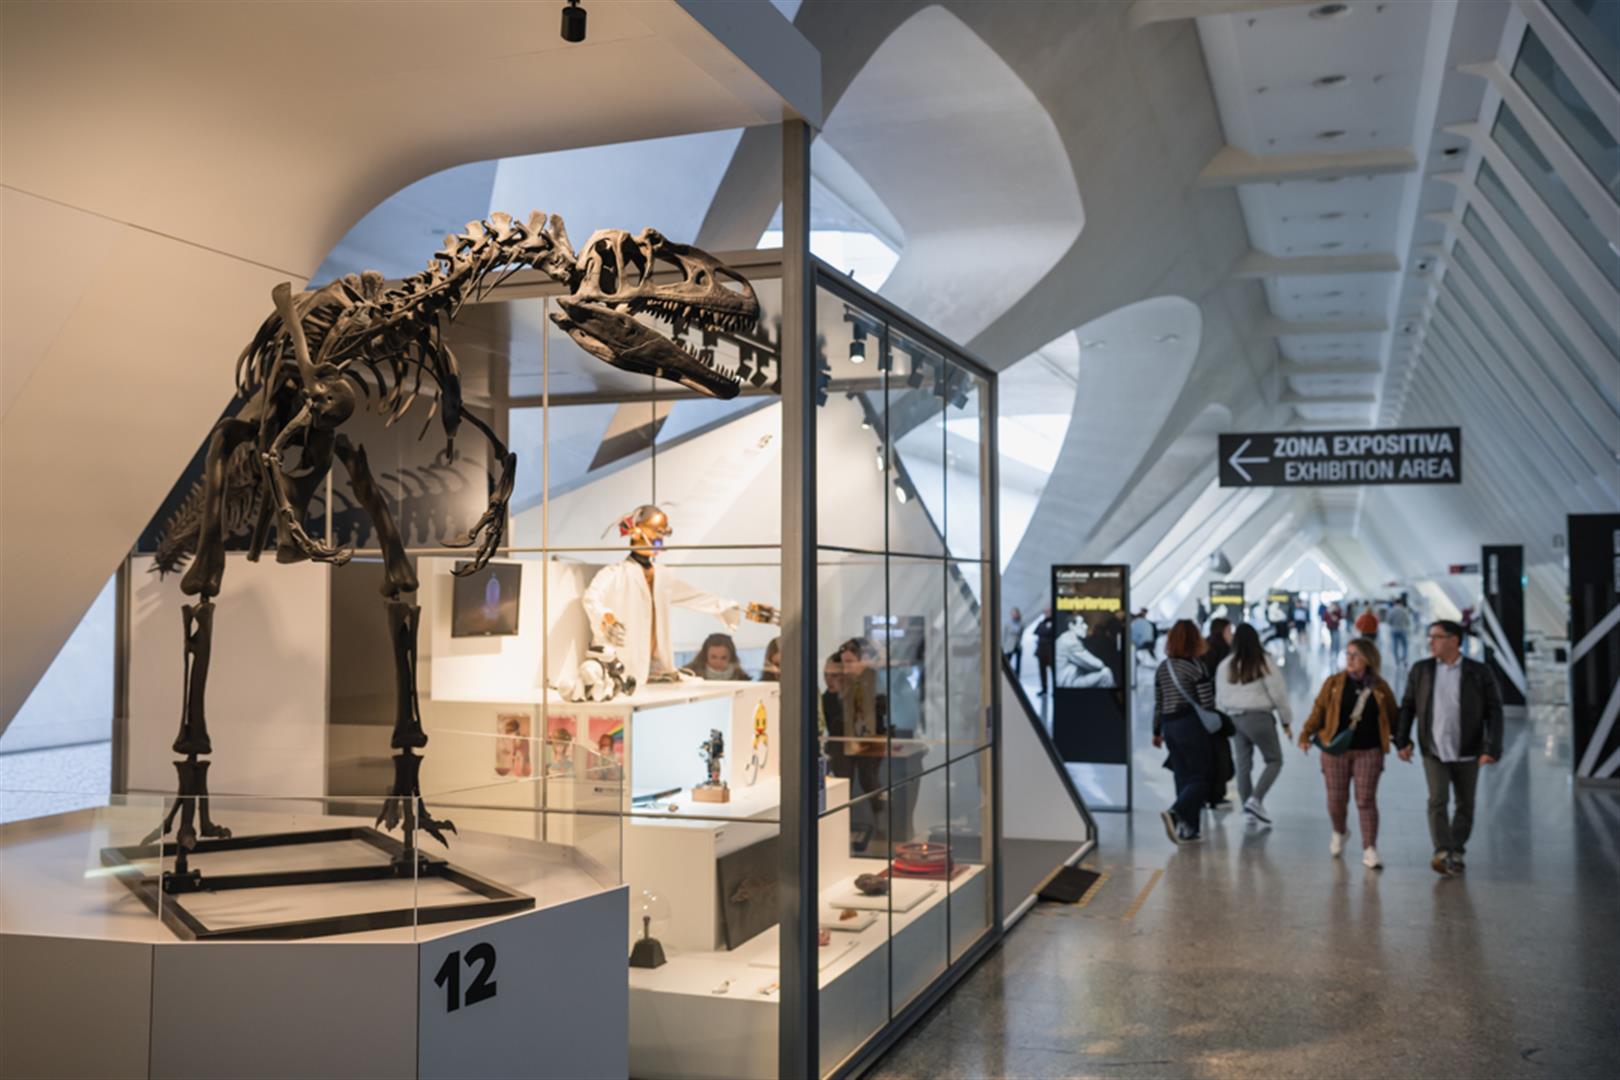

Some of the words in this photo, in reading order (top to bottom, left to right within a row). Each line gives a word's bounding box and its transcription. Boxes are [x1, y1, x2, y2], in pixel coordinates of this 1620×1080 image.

[1273, 437, 1328, 458] ZONA
[1333, 432, 1454, 456] EXPOSITIVA
[1284, 459, 1394, 482] EXHIBITION
[1398, 458, 1454, 479] AREA
[433, 942, 497, 1014] 12
